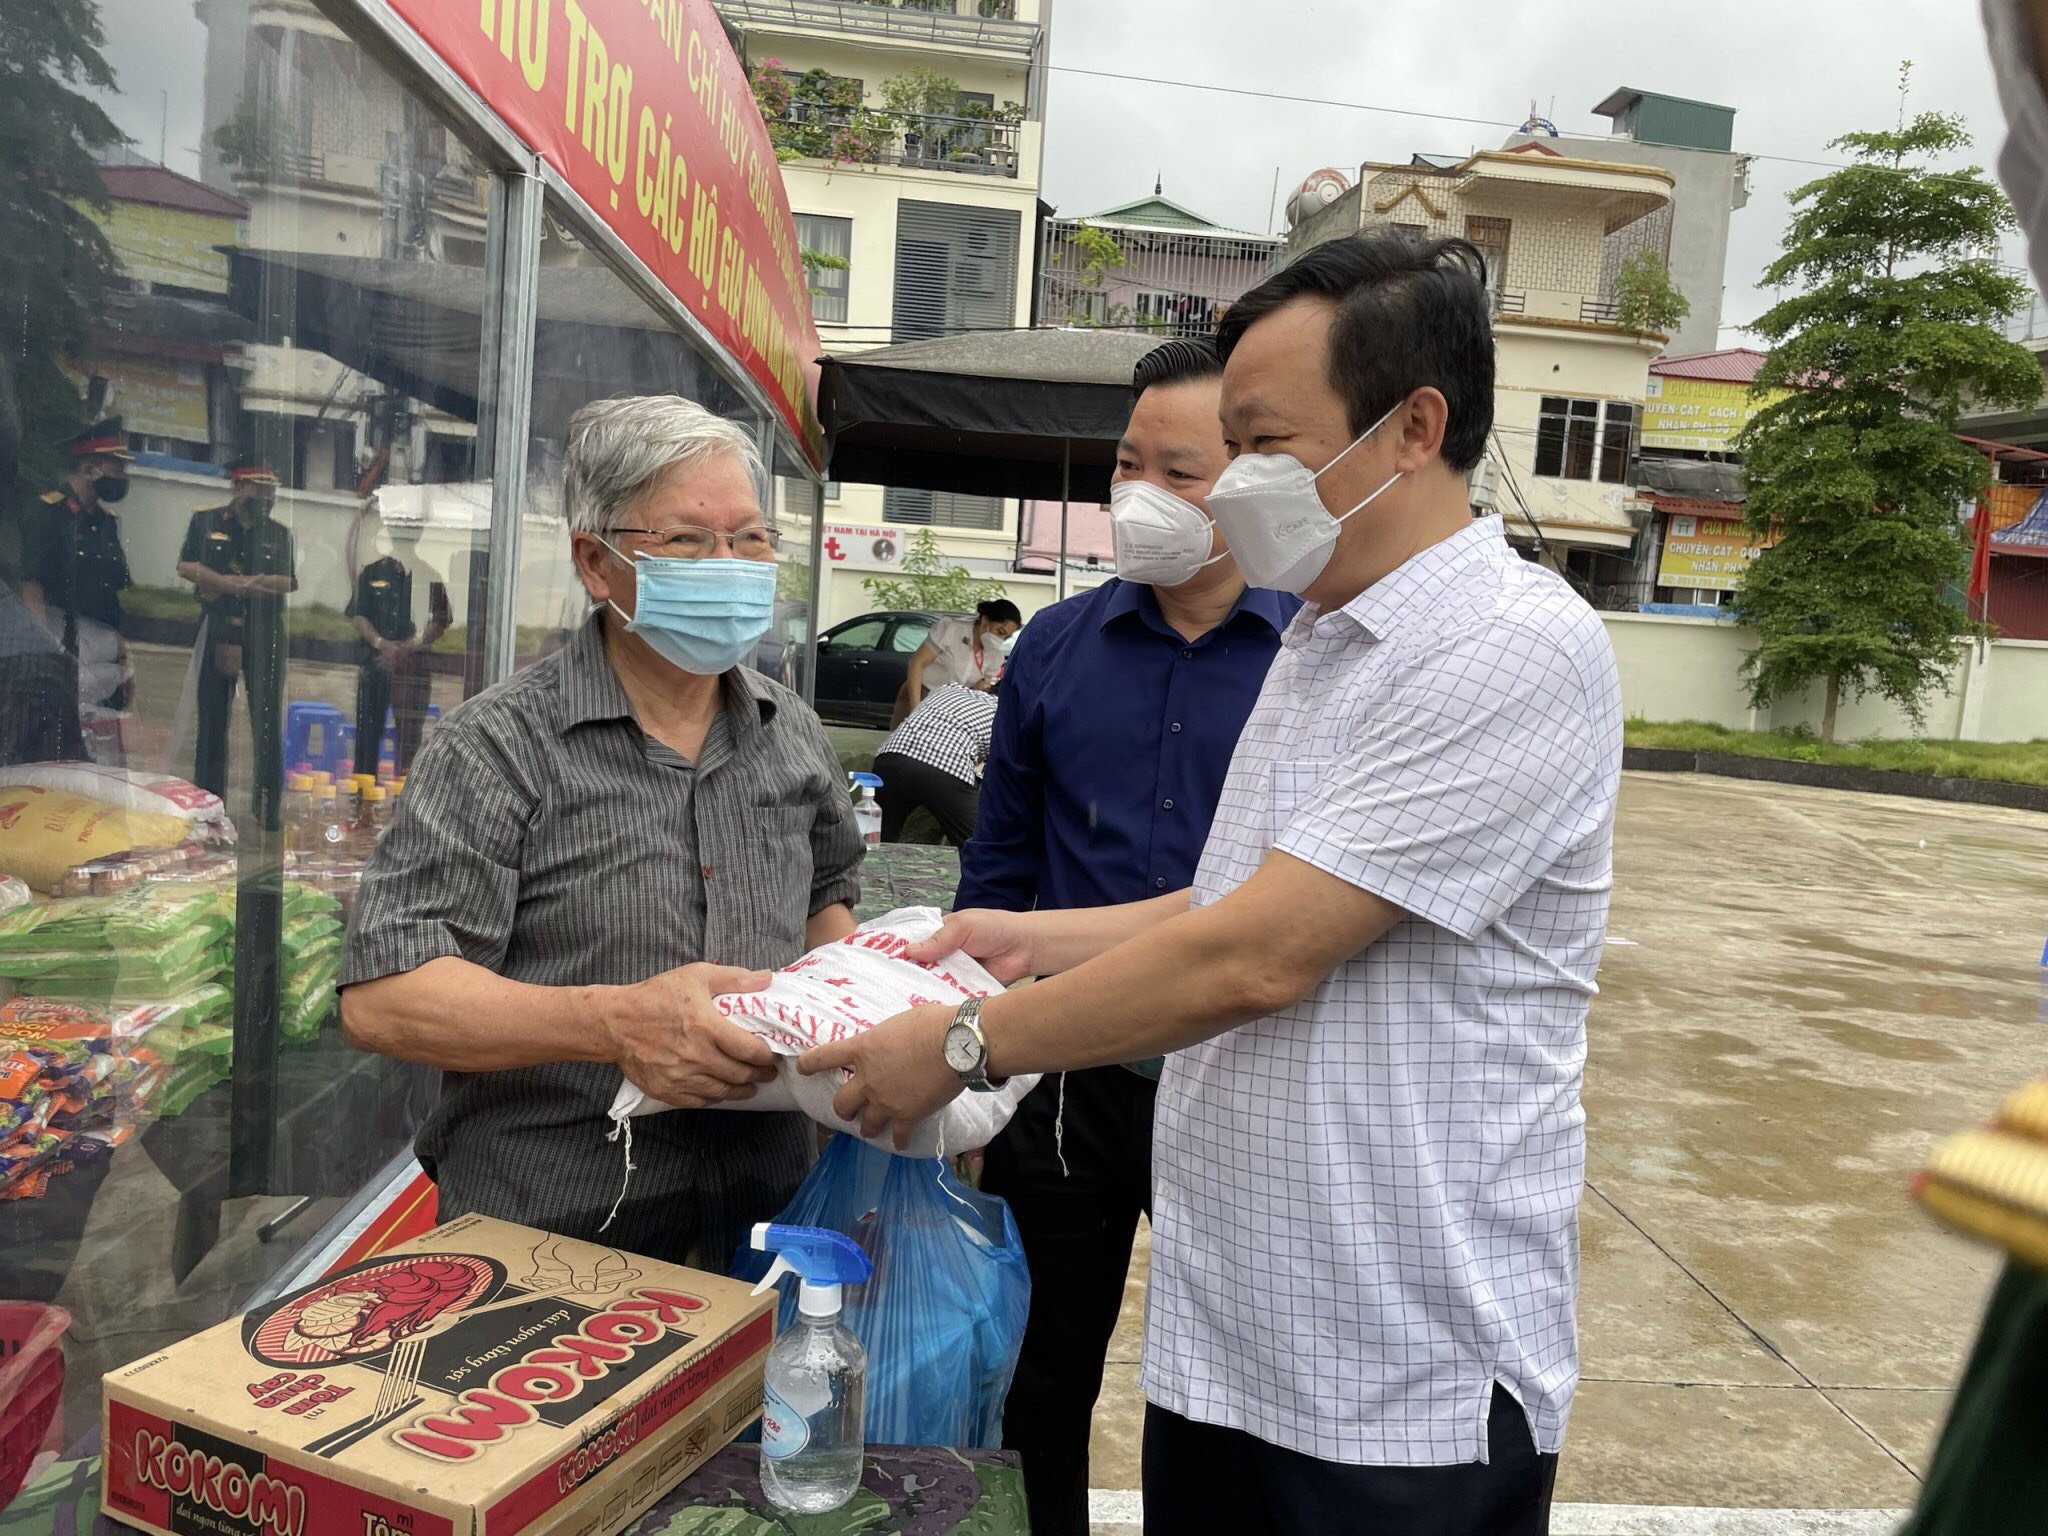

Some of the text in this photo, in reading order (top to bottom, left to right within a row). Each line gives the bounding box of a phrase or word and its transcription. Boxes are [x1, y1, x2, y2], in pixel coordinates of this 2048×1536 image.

[687, 28, 721, 126] CHỈ
[719, 88, 749, 178] HUY
[564, 0, 634, 212] TRỢ
[635, 104, 688, 256] CÁC
[688, 183, 718, 311] HỘ
[717, 225, 745, 324] GIA
[505, 1322, 547, 1346] ngon
[543, 1308, 571, 1326] dai
[246, 1372, 298, 1399] cay
[393, 1287, 710, 1461] KOKOMI
[135, 1429, 306, 1536] KOKOMI
[558, 1411, 639, 1495] KOKOMI
[176, 1502, 192, 1520] dai
[193, 1513, 216, 1531] ngon
